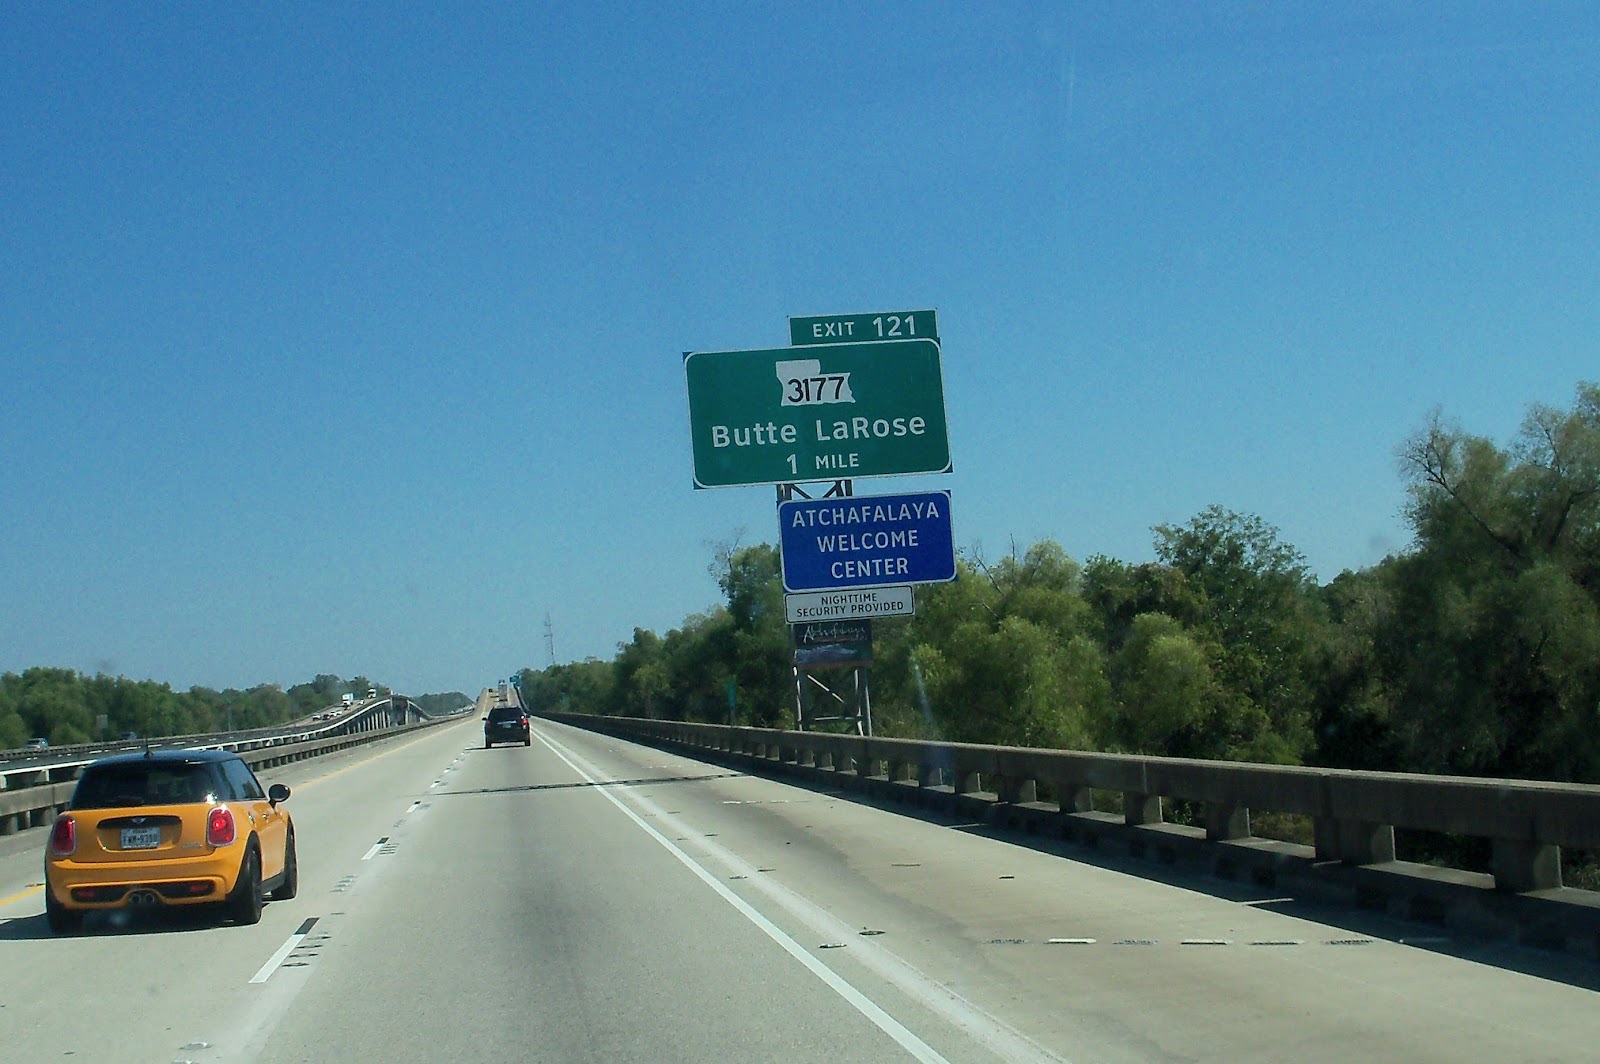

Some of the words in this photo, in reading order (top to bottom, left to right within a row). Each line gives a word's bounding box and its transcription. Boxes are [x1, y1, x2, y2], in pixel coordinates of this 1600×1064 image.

[812, 321, 855, 338] EXIT
[872, 315, 916, 337] 121
[787, 376, 845, 403] 3177
[711, 421, 797, 448] Butte
[815, 416, 926, 442] LaRose
[786, 453, 798, 475] 1
[815, 453, 860, 470] MILE
[792, 501, 940, 528] ATCHAFALAYA
[816, 529, 919, 553] WELCOME
[831, 557, 909, 579] CENTER
[796, 605, 846, 618] SECURITY
[851, 601, 904, 614] PROVIDED
[821, 593, 877, 606] NIGHTTIME
